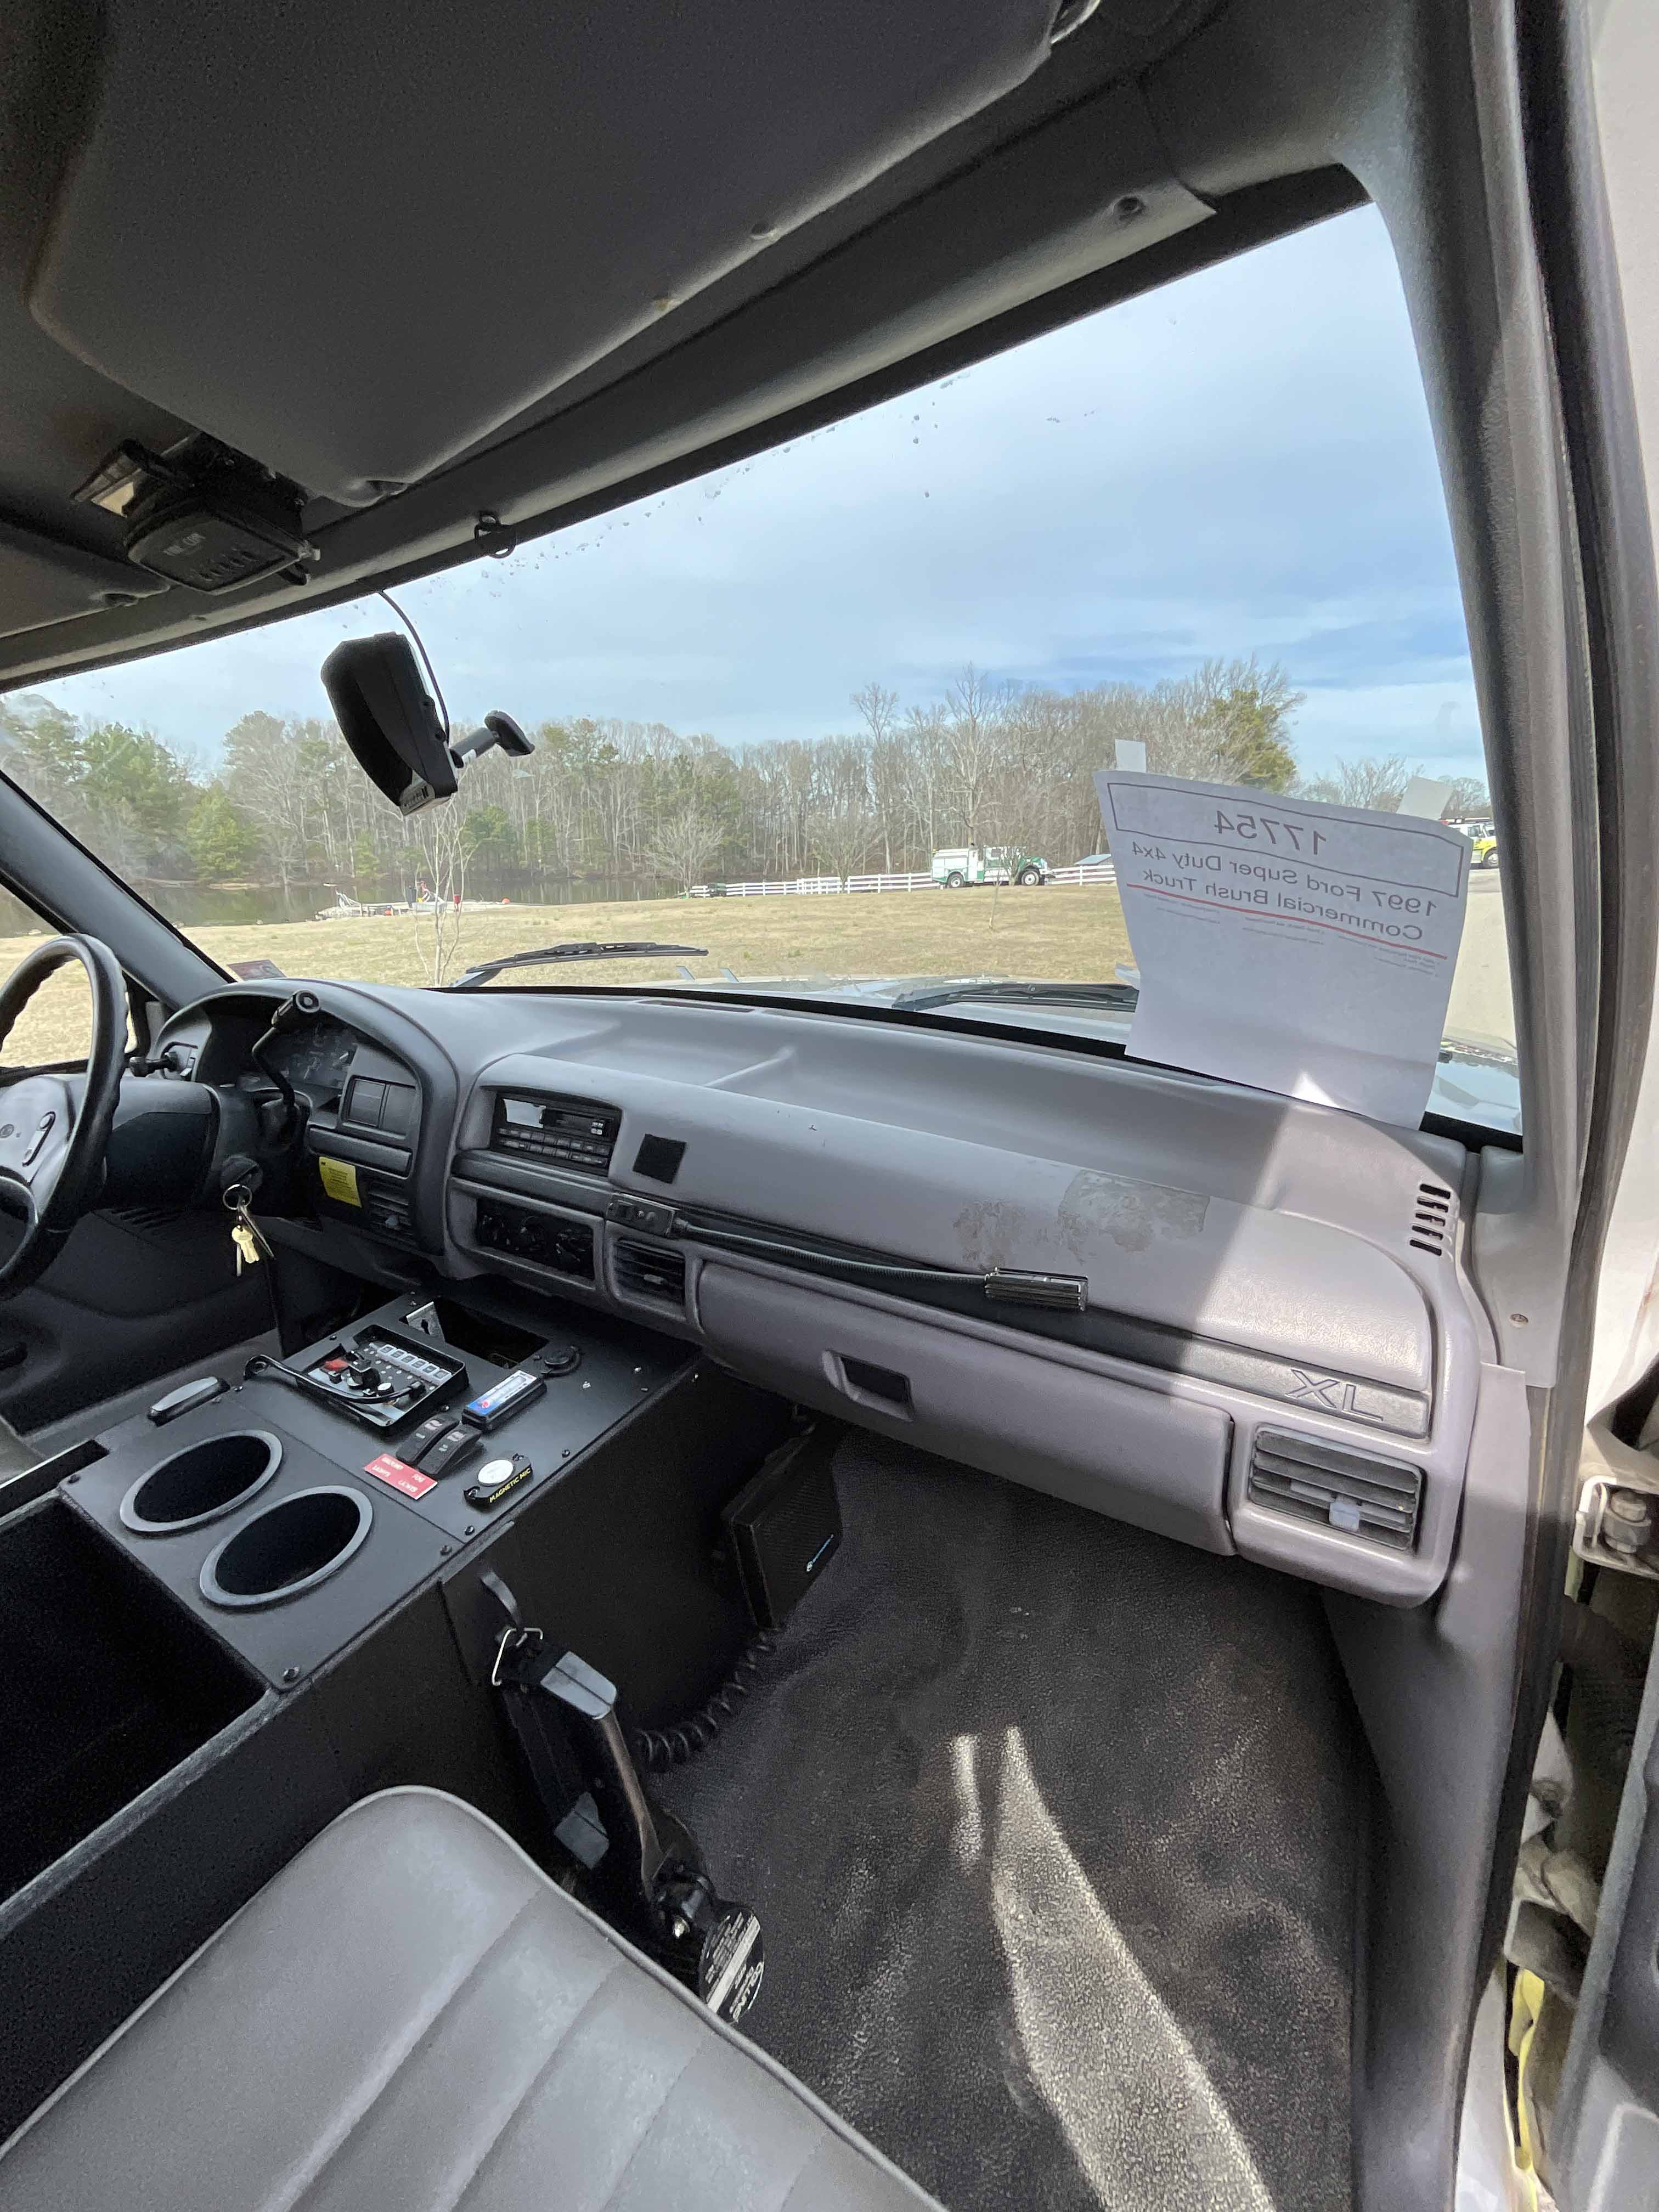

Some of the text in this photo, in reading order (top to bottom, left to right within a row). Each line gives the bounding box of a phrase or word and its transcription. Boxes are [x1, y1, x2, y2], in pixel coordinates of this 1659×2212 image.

[1284, 1367, 1384, 1423] XL
[489, 1468, 531, 1503] MAGNETIC MIC
